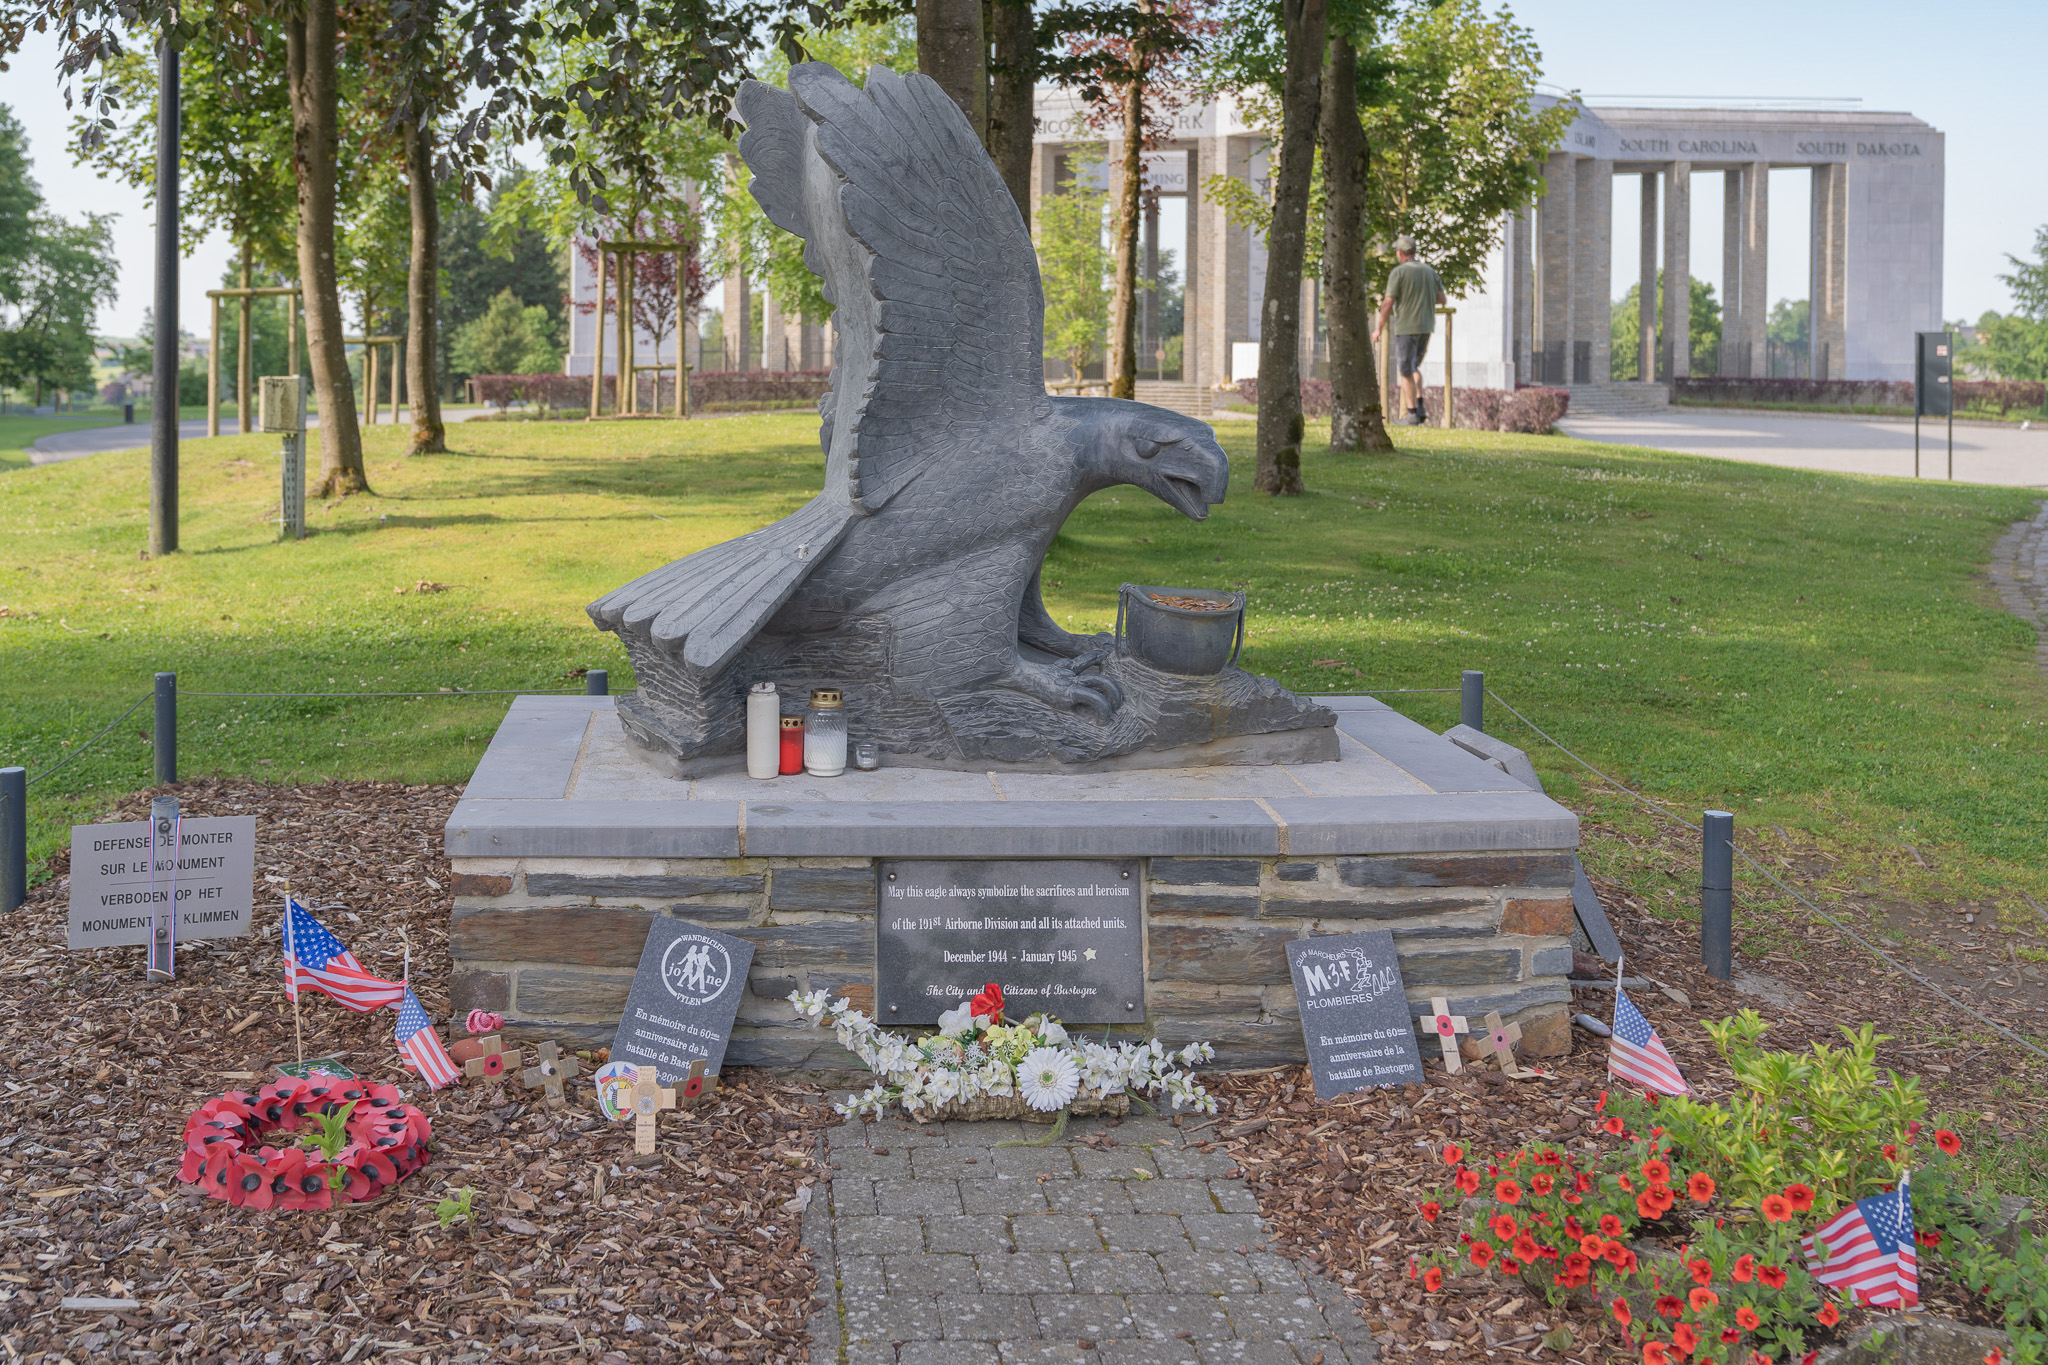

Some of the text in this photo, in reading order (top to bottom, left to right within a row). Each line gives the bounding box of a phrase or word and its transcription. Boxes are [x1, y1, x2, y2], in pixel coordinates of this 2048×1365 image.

[1618, 138, 1759, 154] SOUTH CAROLINA
[1795, 141, 1921, 156] SOUTH DAKOTA
[94, 837, 150, 852] DEFENSE
[181, 832, 233, 846] MONTER
[100, 857, 225, 876] SUR LE MONUMENT
[101, 887, 223, 906] VERBODEN OP HET
[888, 883, 1130, 900] May this eagle always symbolize the sacrifices and heroism
[82, 916, 152, 932] MONUMENT
[183, 910, 239, 925] KLIMMEN
[892, 917, 902, 930] of
[902, 917, 917, 930] the
[945, 917, 983, 930] Airborne
[984, 917, 1019, 930] Division
[1020, 916, 1036, 930] and
[1038, 916, 1050, 929] all
[1051, 916, 1063, 929] its
[1064, 916, 1101, 929] attached
[1102, 916, 1127, 929] units.
[681, 934, 727, 954] WANDELCLUB
[943, 950, 986, 963] December
[987, 950, 1008, 963] 1944
[1020, 950, 1056, 965] January
[1057, 950, 1077, 962] 1945
[1295, 948, 1347, 968] CLUB MARCHEURS
[676, 992, 701, 1006] VYLEN
[925, 983, 1098, 998] The City and Citizens of Bastogne
[1306, 992, 1374, 1010] PLOMBIERES
[634, 1007, 648, 1020] En
[649, 1014, 687, 1032] mémoire
[687, 1024, 699, 1036] du
[634, 1028, 709, 1057] anniversaire de la
[1320, 1035, 1334, 1046] En
[1335, 1032, 1373, 1045] mémoire
[1373, 1029, 1386, 1039] du
[626, 1041, 658, 1060] bataille
[658, 1052, 669, 1063] de
[669, 1054, 710, 1076] Baste
[1329, 1044, 1405, 1063] anniversaire de la
[1328, 1063, 1415, 1081] bataille de Bastogne
